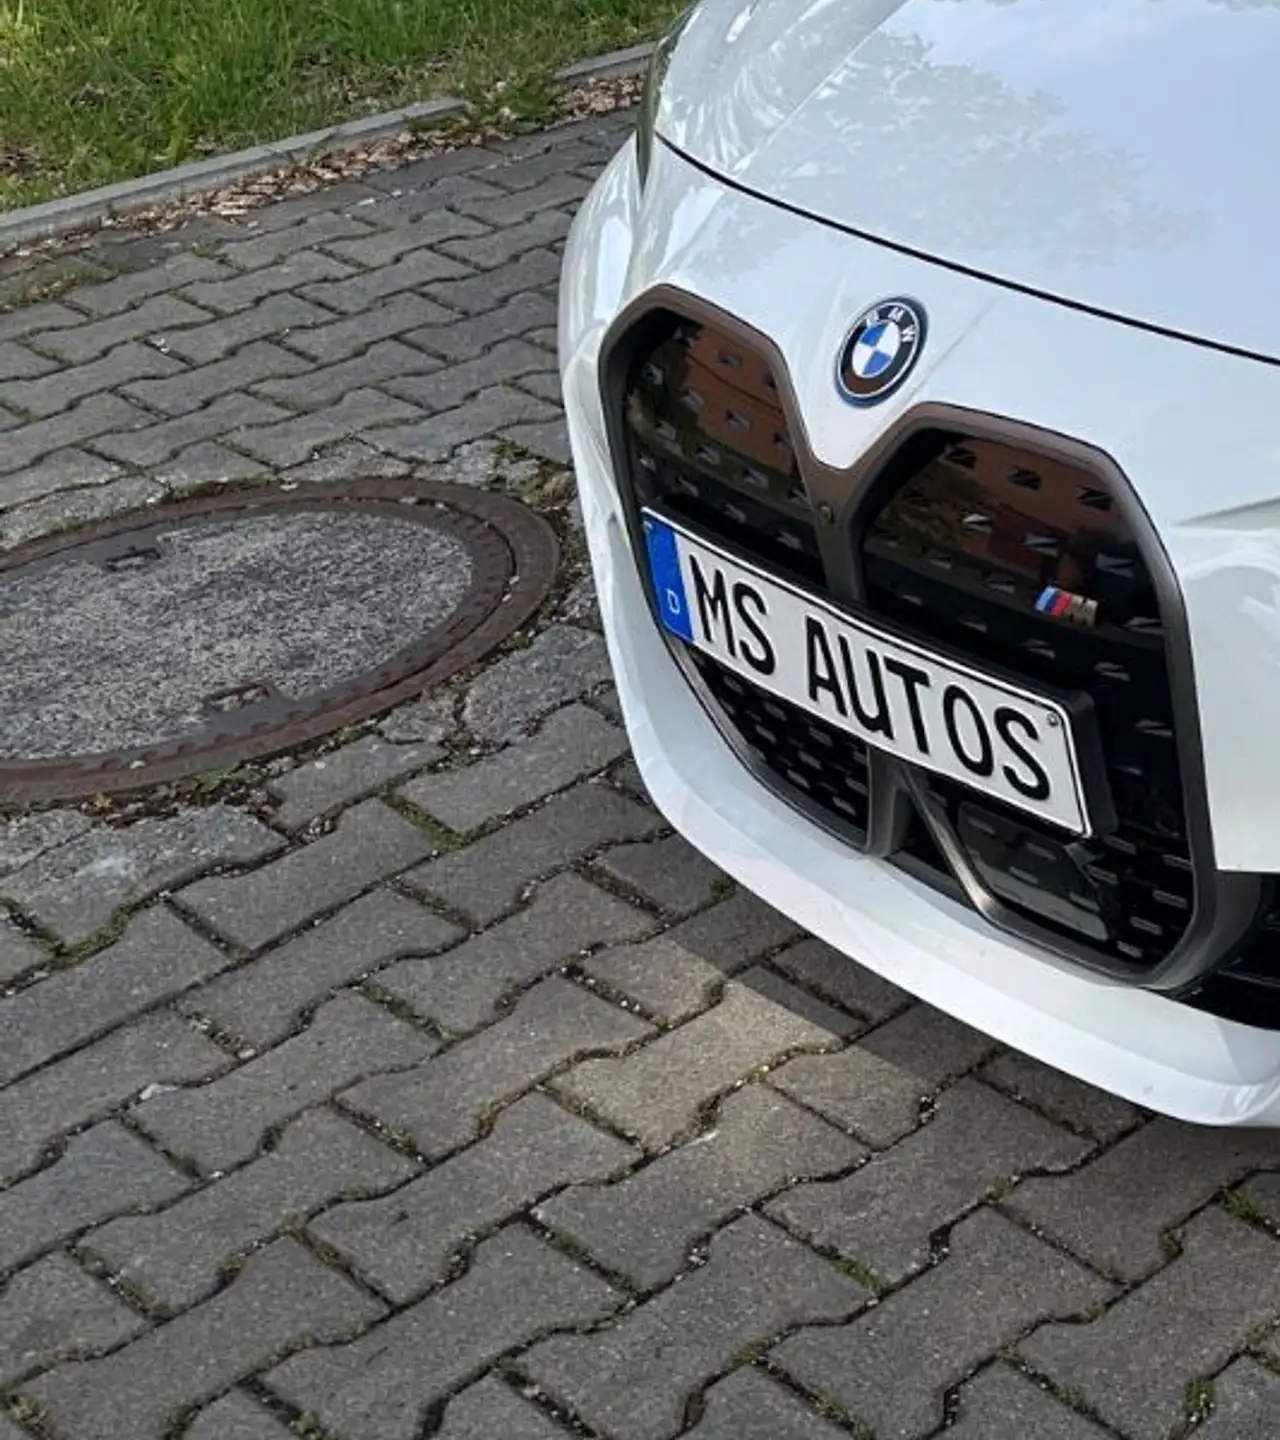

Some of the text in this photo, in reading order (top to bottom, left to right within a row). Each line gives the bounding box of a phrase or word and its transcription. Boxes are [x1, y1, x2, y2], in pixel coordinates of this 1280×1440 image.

[864, 306, 917, 344] BMW
[666, 588, 681, 615] D
[689, 554, 1052, 801] MS AUTOS
